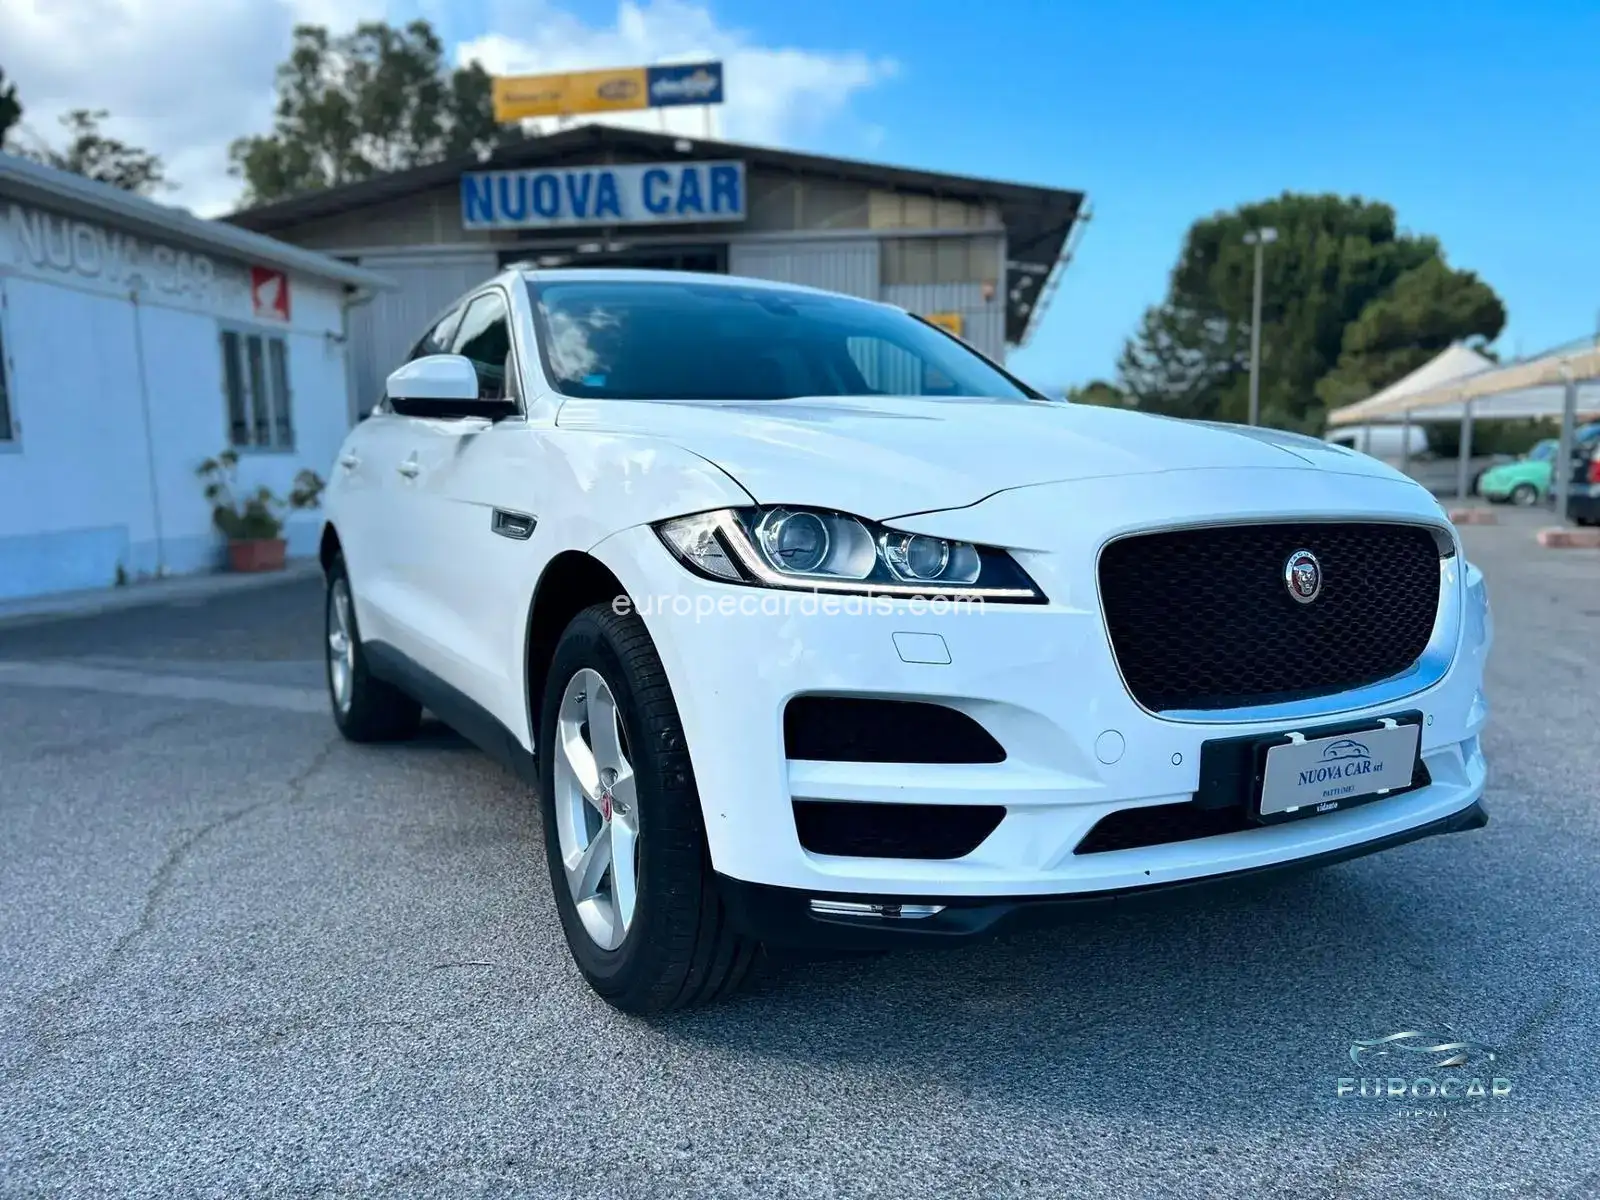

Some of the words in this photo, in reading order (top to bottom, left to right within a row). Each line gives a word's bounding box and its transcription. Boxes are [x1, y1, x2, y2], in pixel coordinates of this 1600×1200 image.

[463, 170, 622, 223] NUOVA
[642, 165, 741, 215] CAR
[8, 204, 148, 291] NUOVA
[1298, 766, 1342, 786] NUOVA
[1344, 760, 1371, 777] CAR
[1373, 762, 1383, 772] srl
